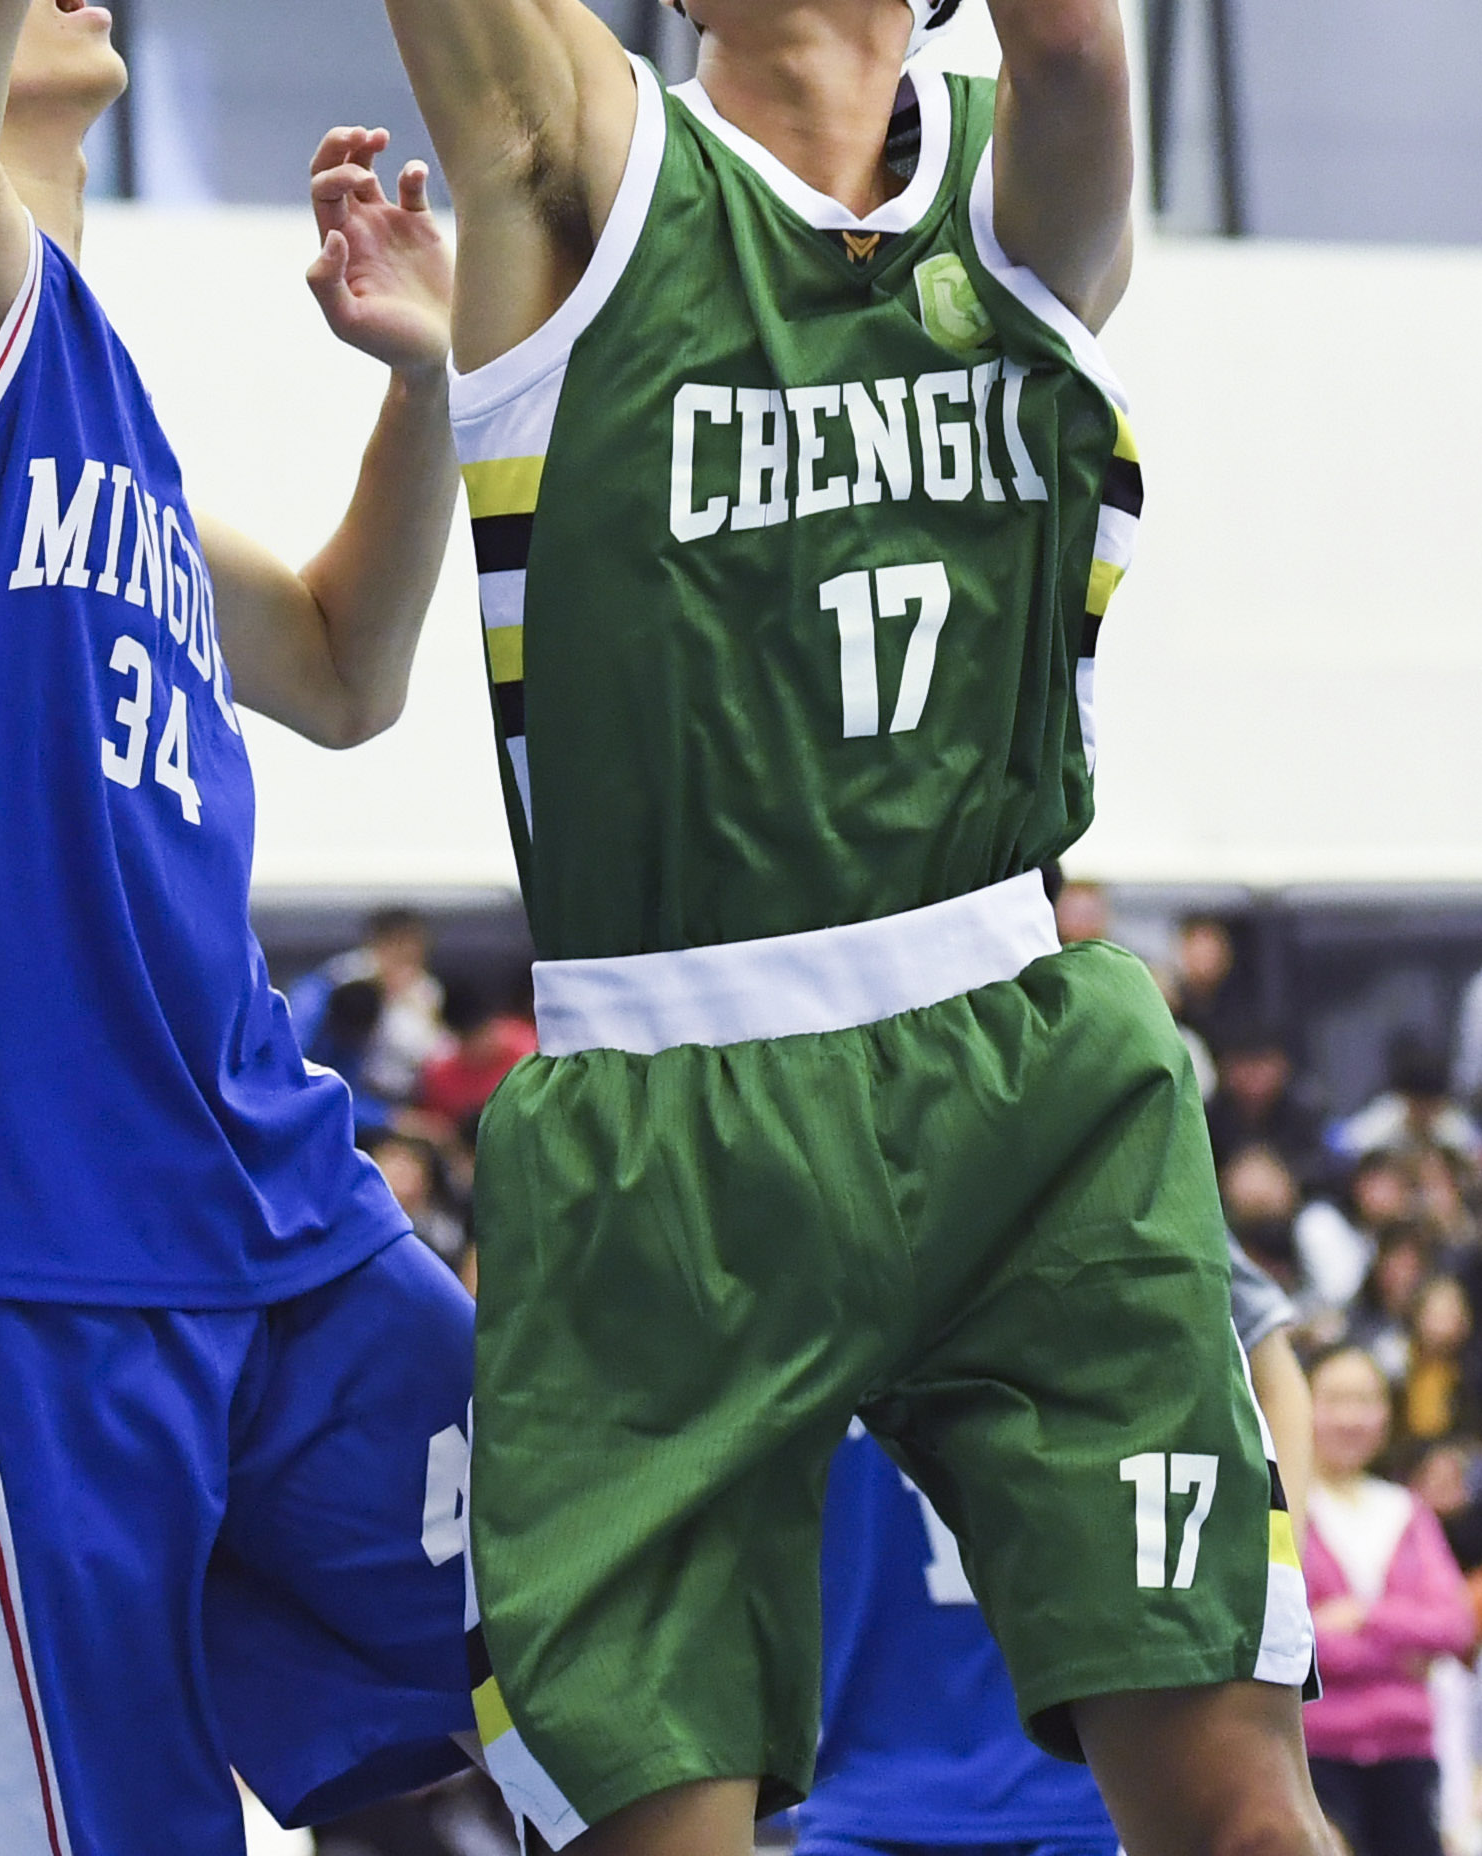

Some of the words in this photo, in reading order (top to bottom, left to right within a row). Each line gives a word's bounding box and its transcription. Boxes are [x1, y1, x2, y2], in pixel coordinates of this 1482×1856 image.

[101, 635, 202, 826] 34
[819, 561, 951, 738] 17
[1119, 1452, 1219, 1590] 17
